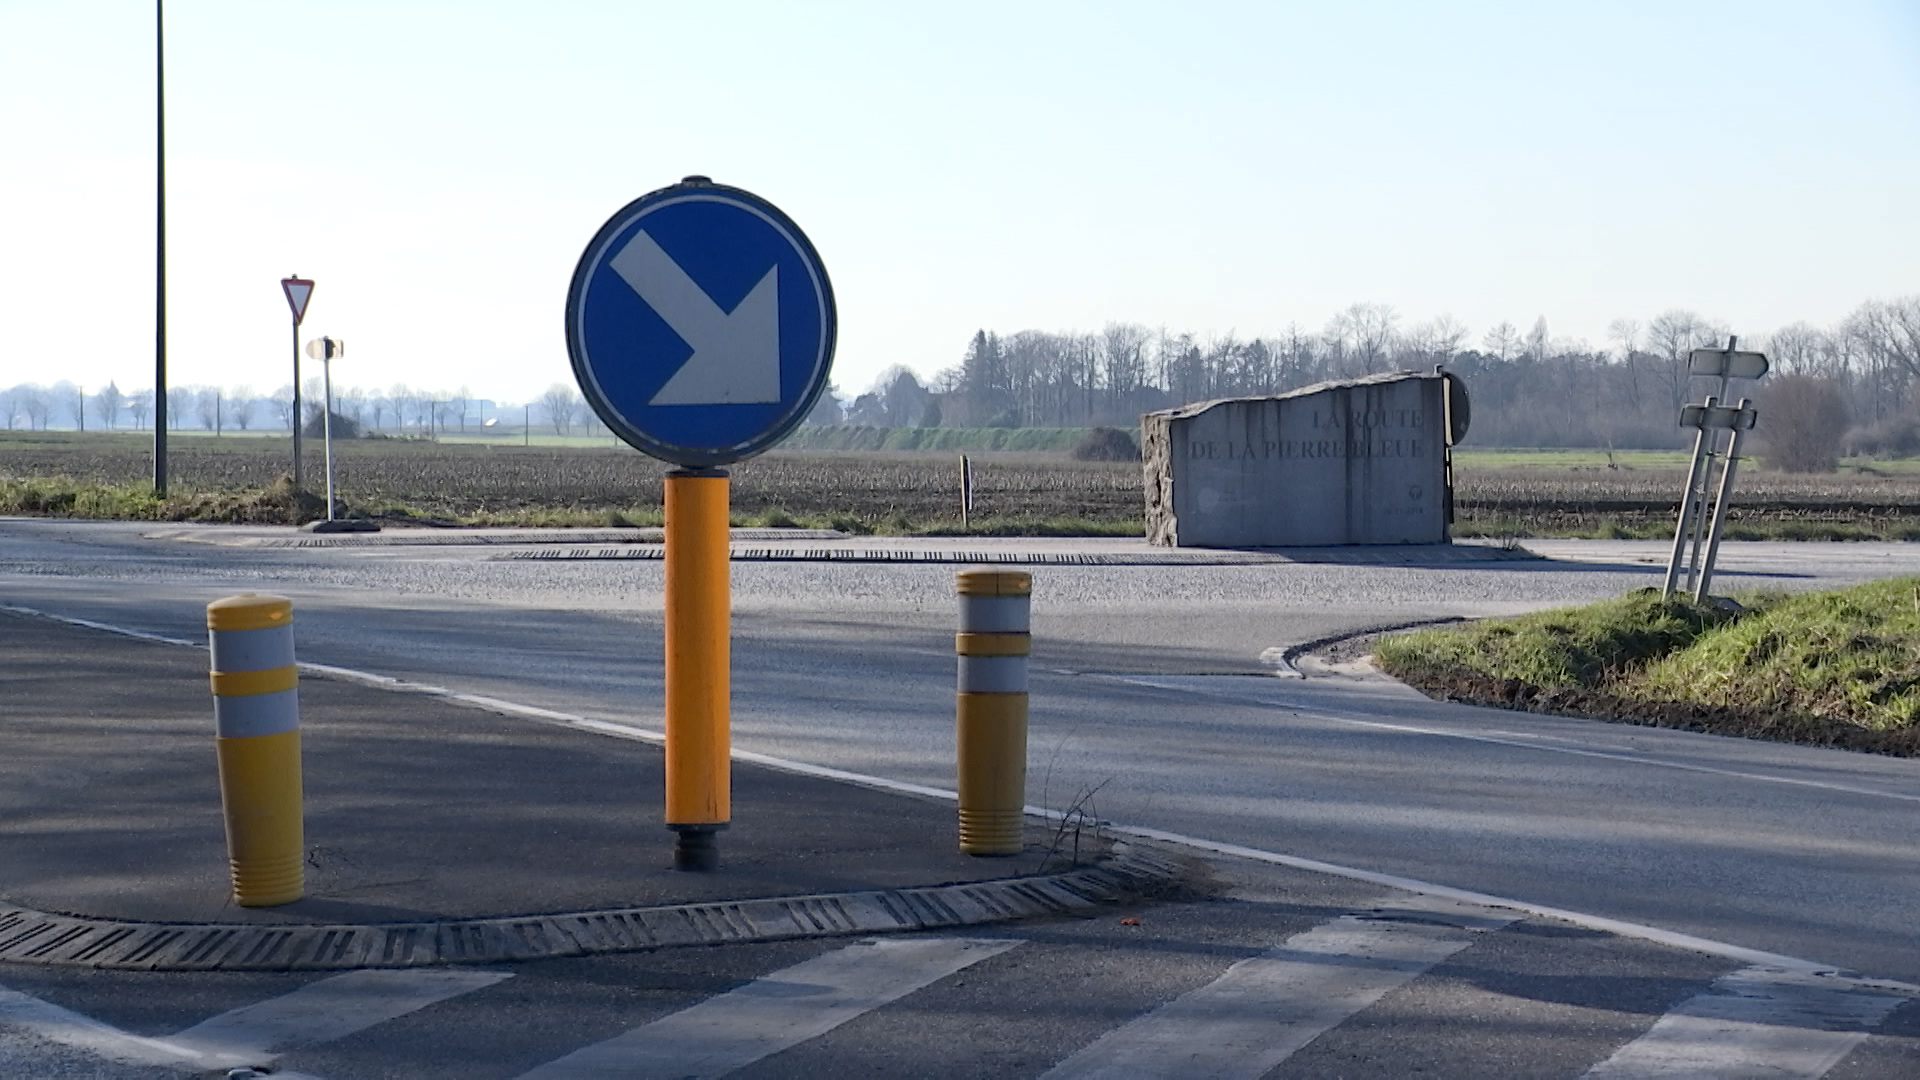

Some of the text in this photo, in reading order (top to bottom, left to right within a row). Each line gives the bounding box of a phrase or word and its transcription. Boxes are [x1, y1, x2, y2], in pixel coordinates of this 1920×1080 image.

[1313, 409, 1424, 428] LA ROUTE
[1191, 439, 1424, 459] DE LA PIERRE BLEUE
